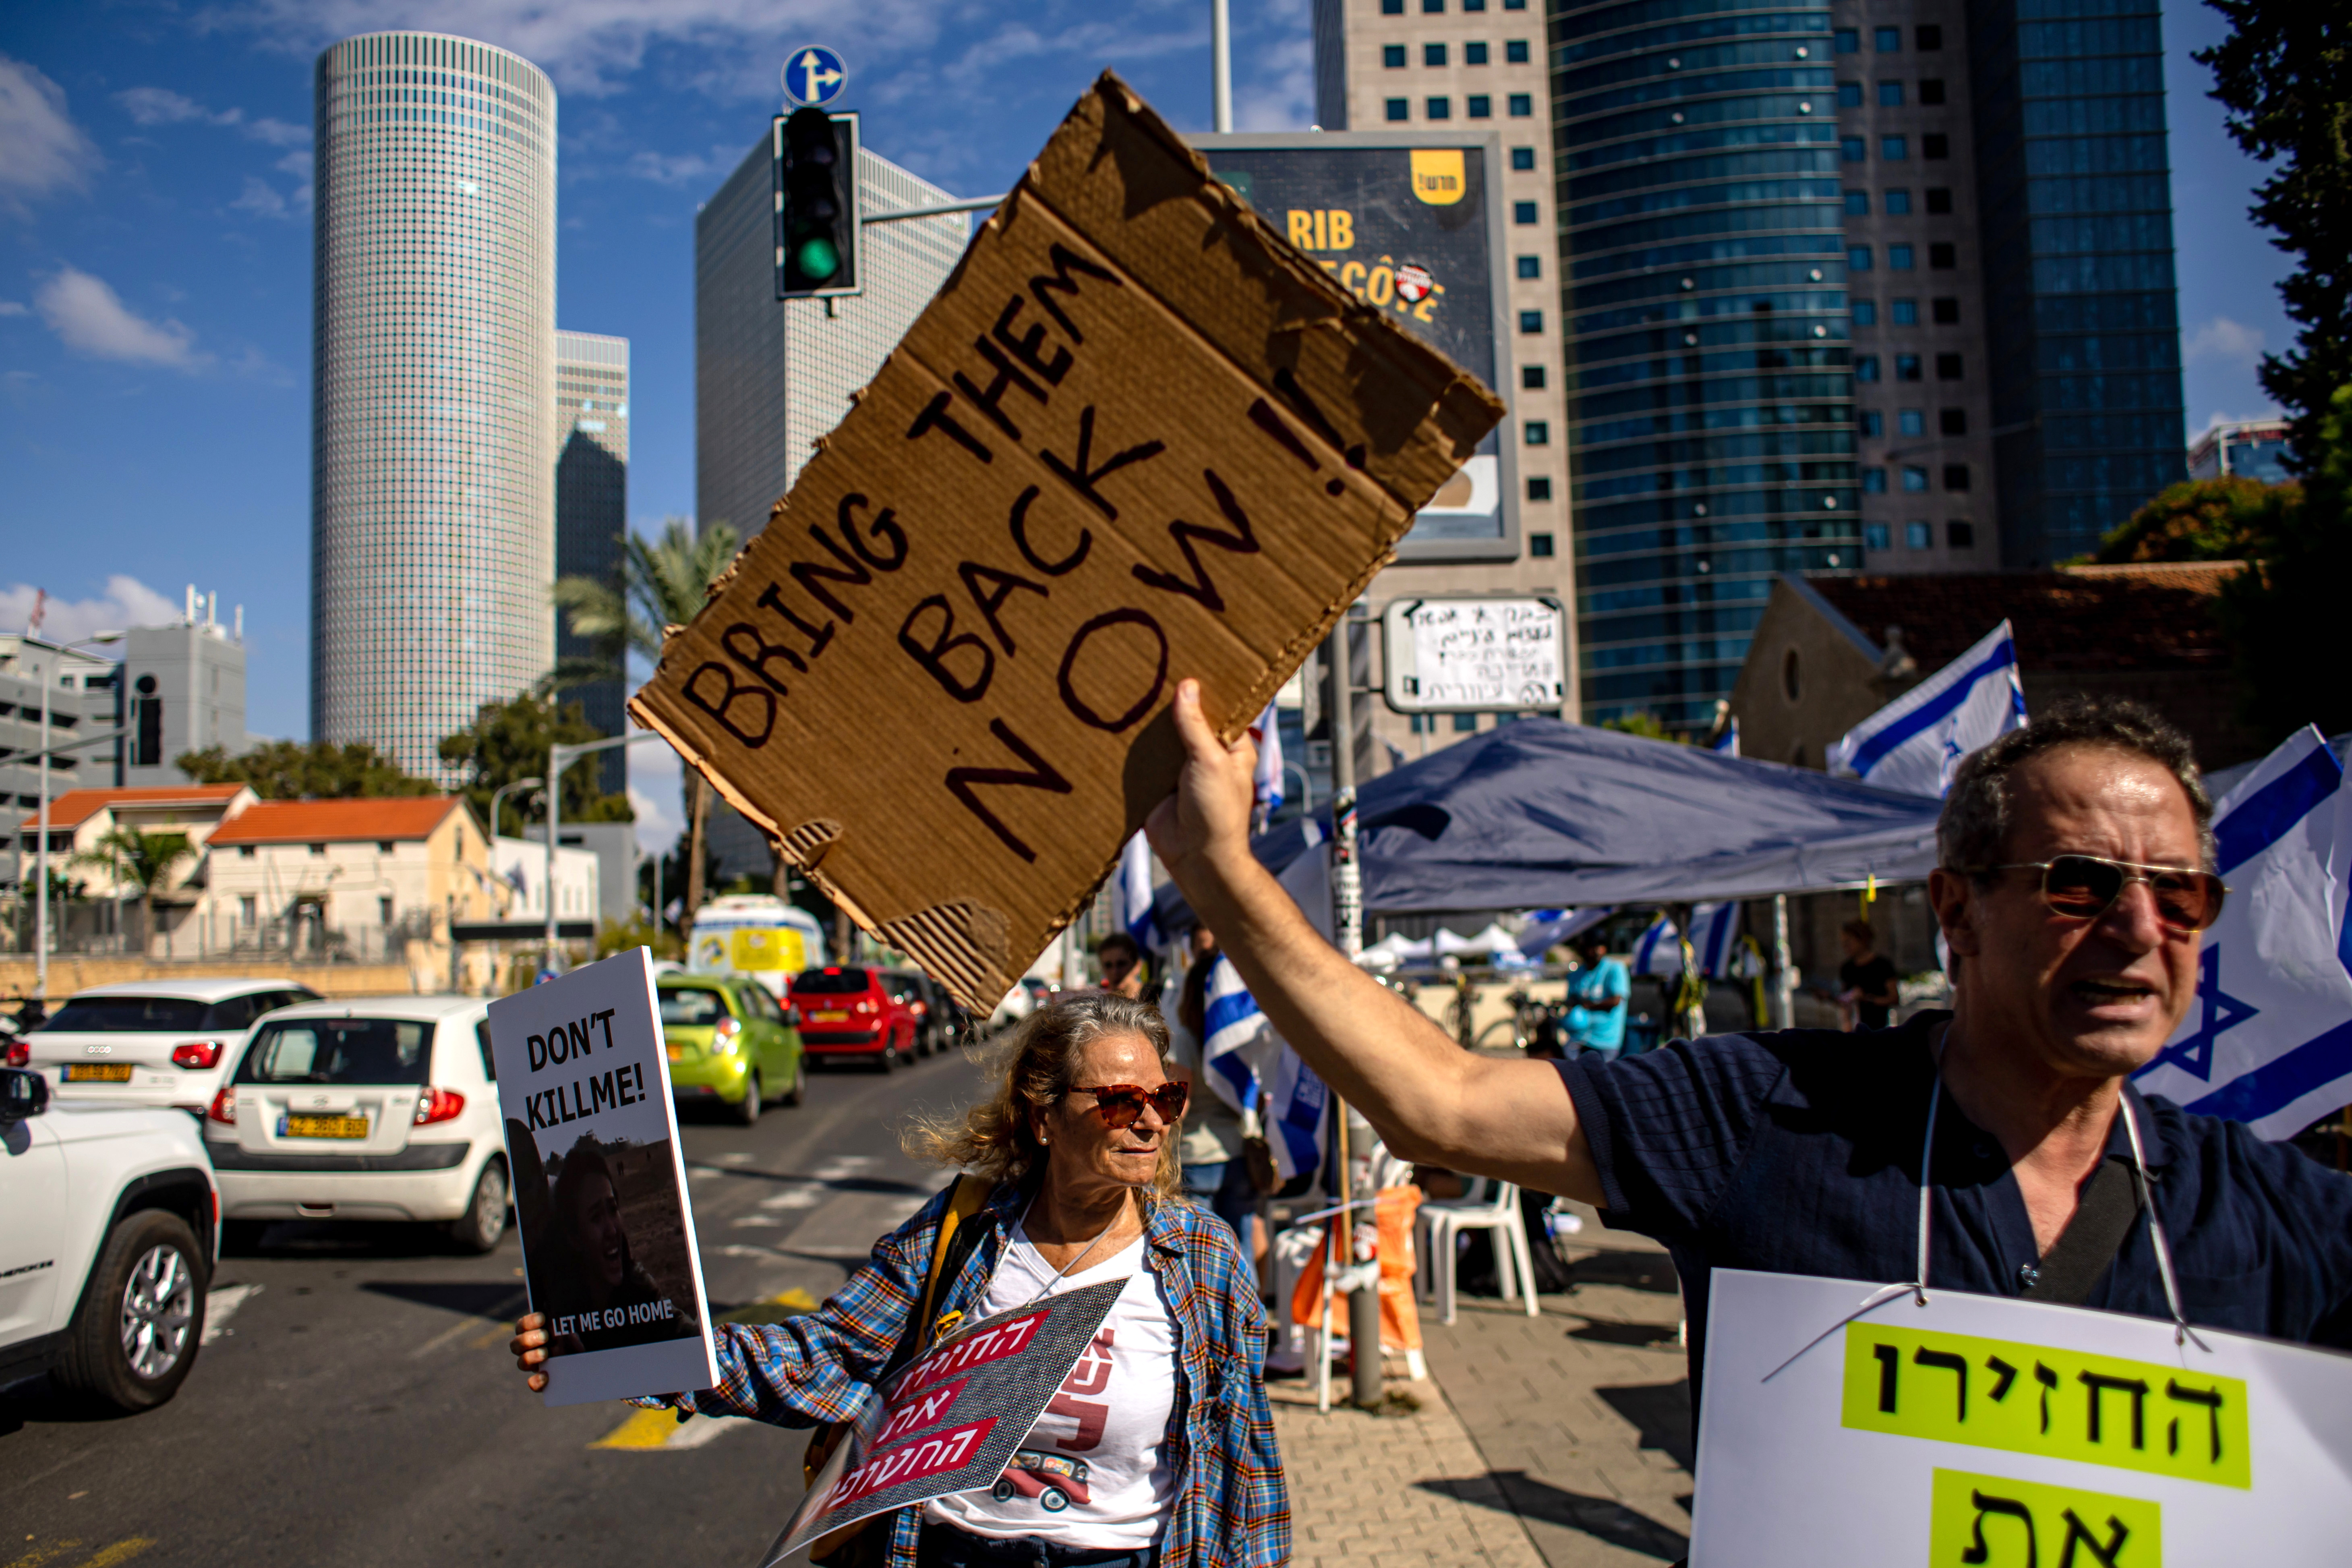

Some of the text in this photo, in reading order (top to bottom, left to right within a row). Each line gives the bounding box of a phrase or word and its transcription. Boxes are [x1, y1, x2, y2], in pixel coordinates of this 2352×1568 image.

[1288, 209, 1355, 251] RIB
[684, 492, 909, 749] BRING
[907, 242, 1122, 462] THEM
[898, 406, 1165, 703] BACK
[527, 1008, 615, 1073] DON'T
[552, 1299, 673, 1336] LET ME GO HOME
[892, 1317, 1035, 1401] החזירו
[877, 1390, 950, 1443] את
[1873, 1342, 2223, 1464] החזירו
[1962, 1487, 2130, 1568] את
